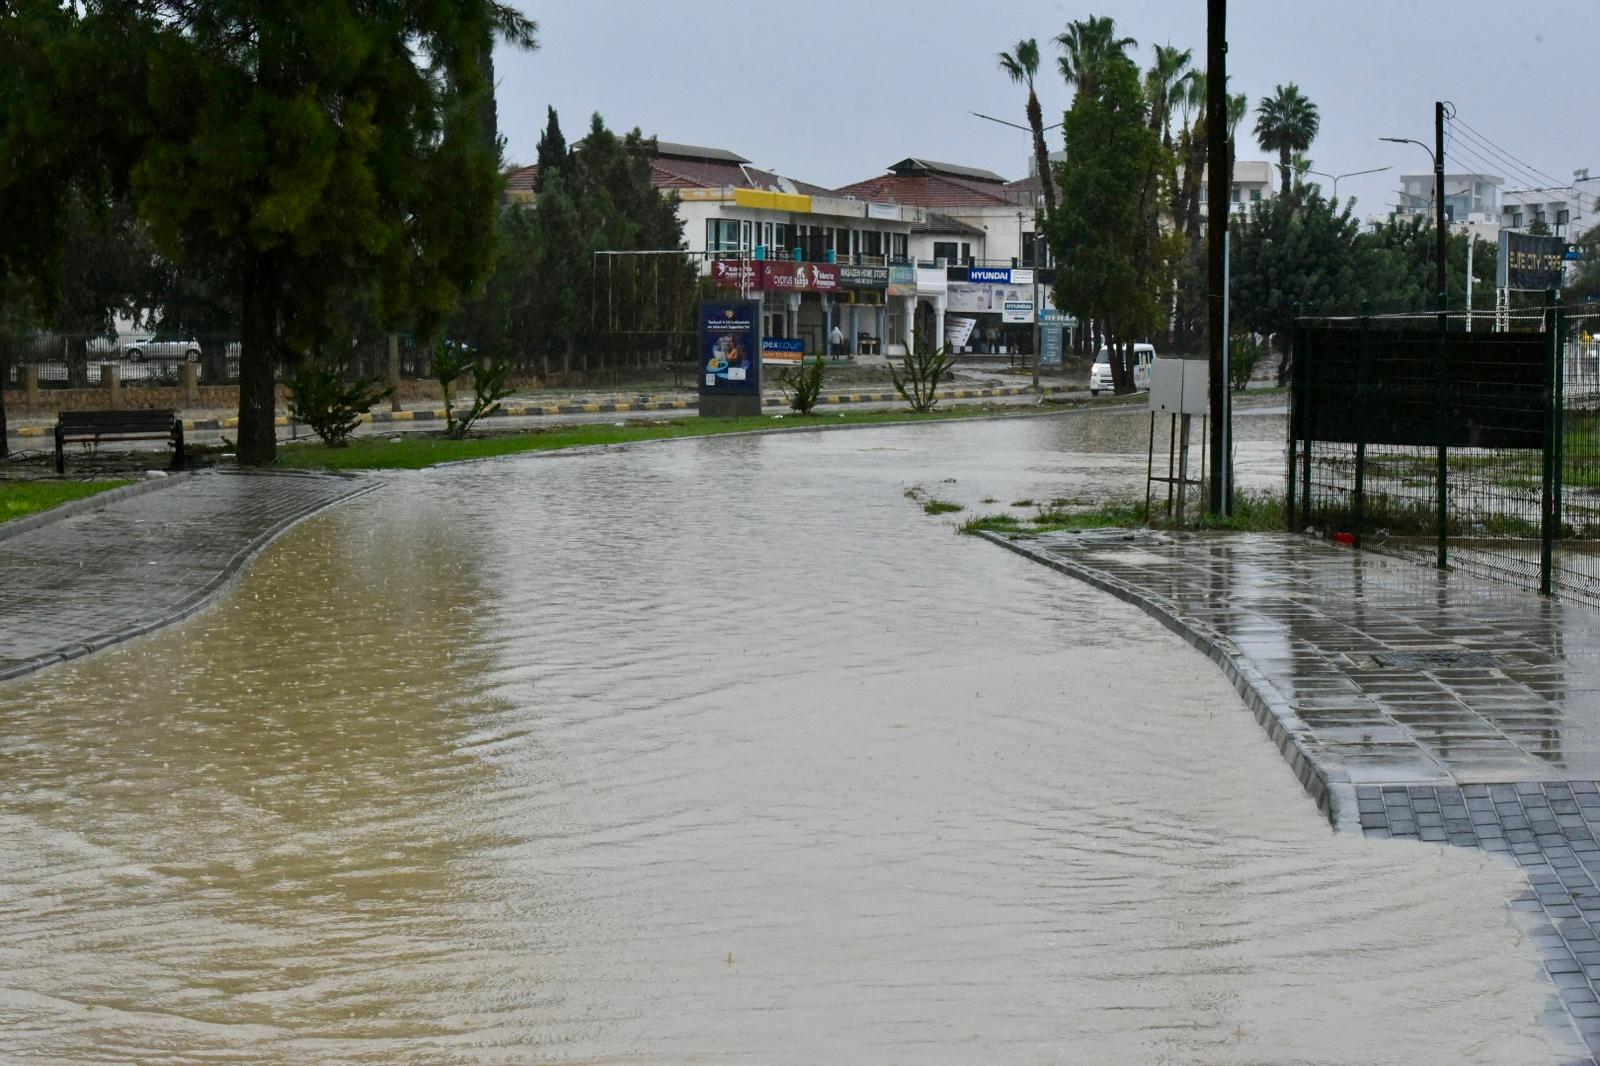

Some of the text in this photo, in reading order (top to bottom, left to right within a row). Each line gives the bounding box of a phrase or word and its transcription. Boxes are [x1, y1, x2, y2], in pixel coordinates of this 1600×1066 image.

[861, 269, 873, 278] HOME
[874, 269, 887, 279] STORE
[971, 271, 1008, 280] HYUNDAI
